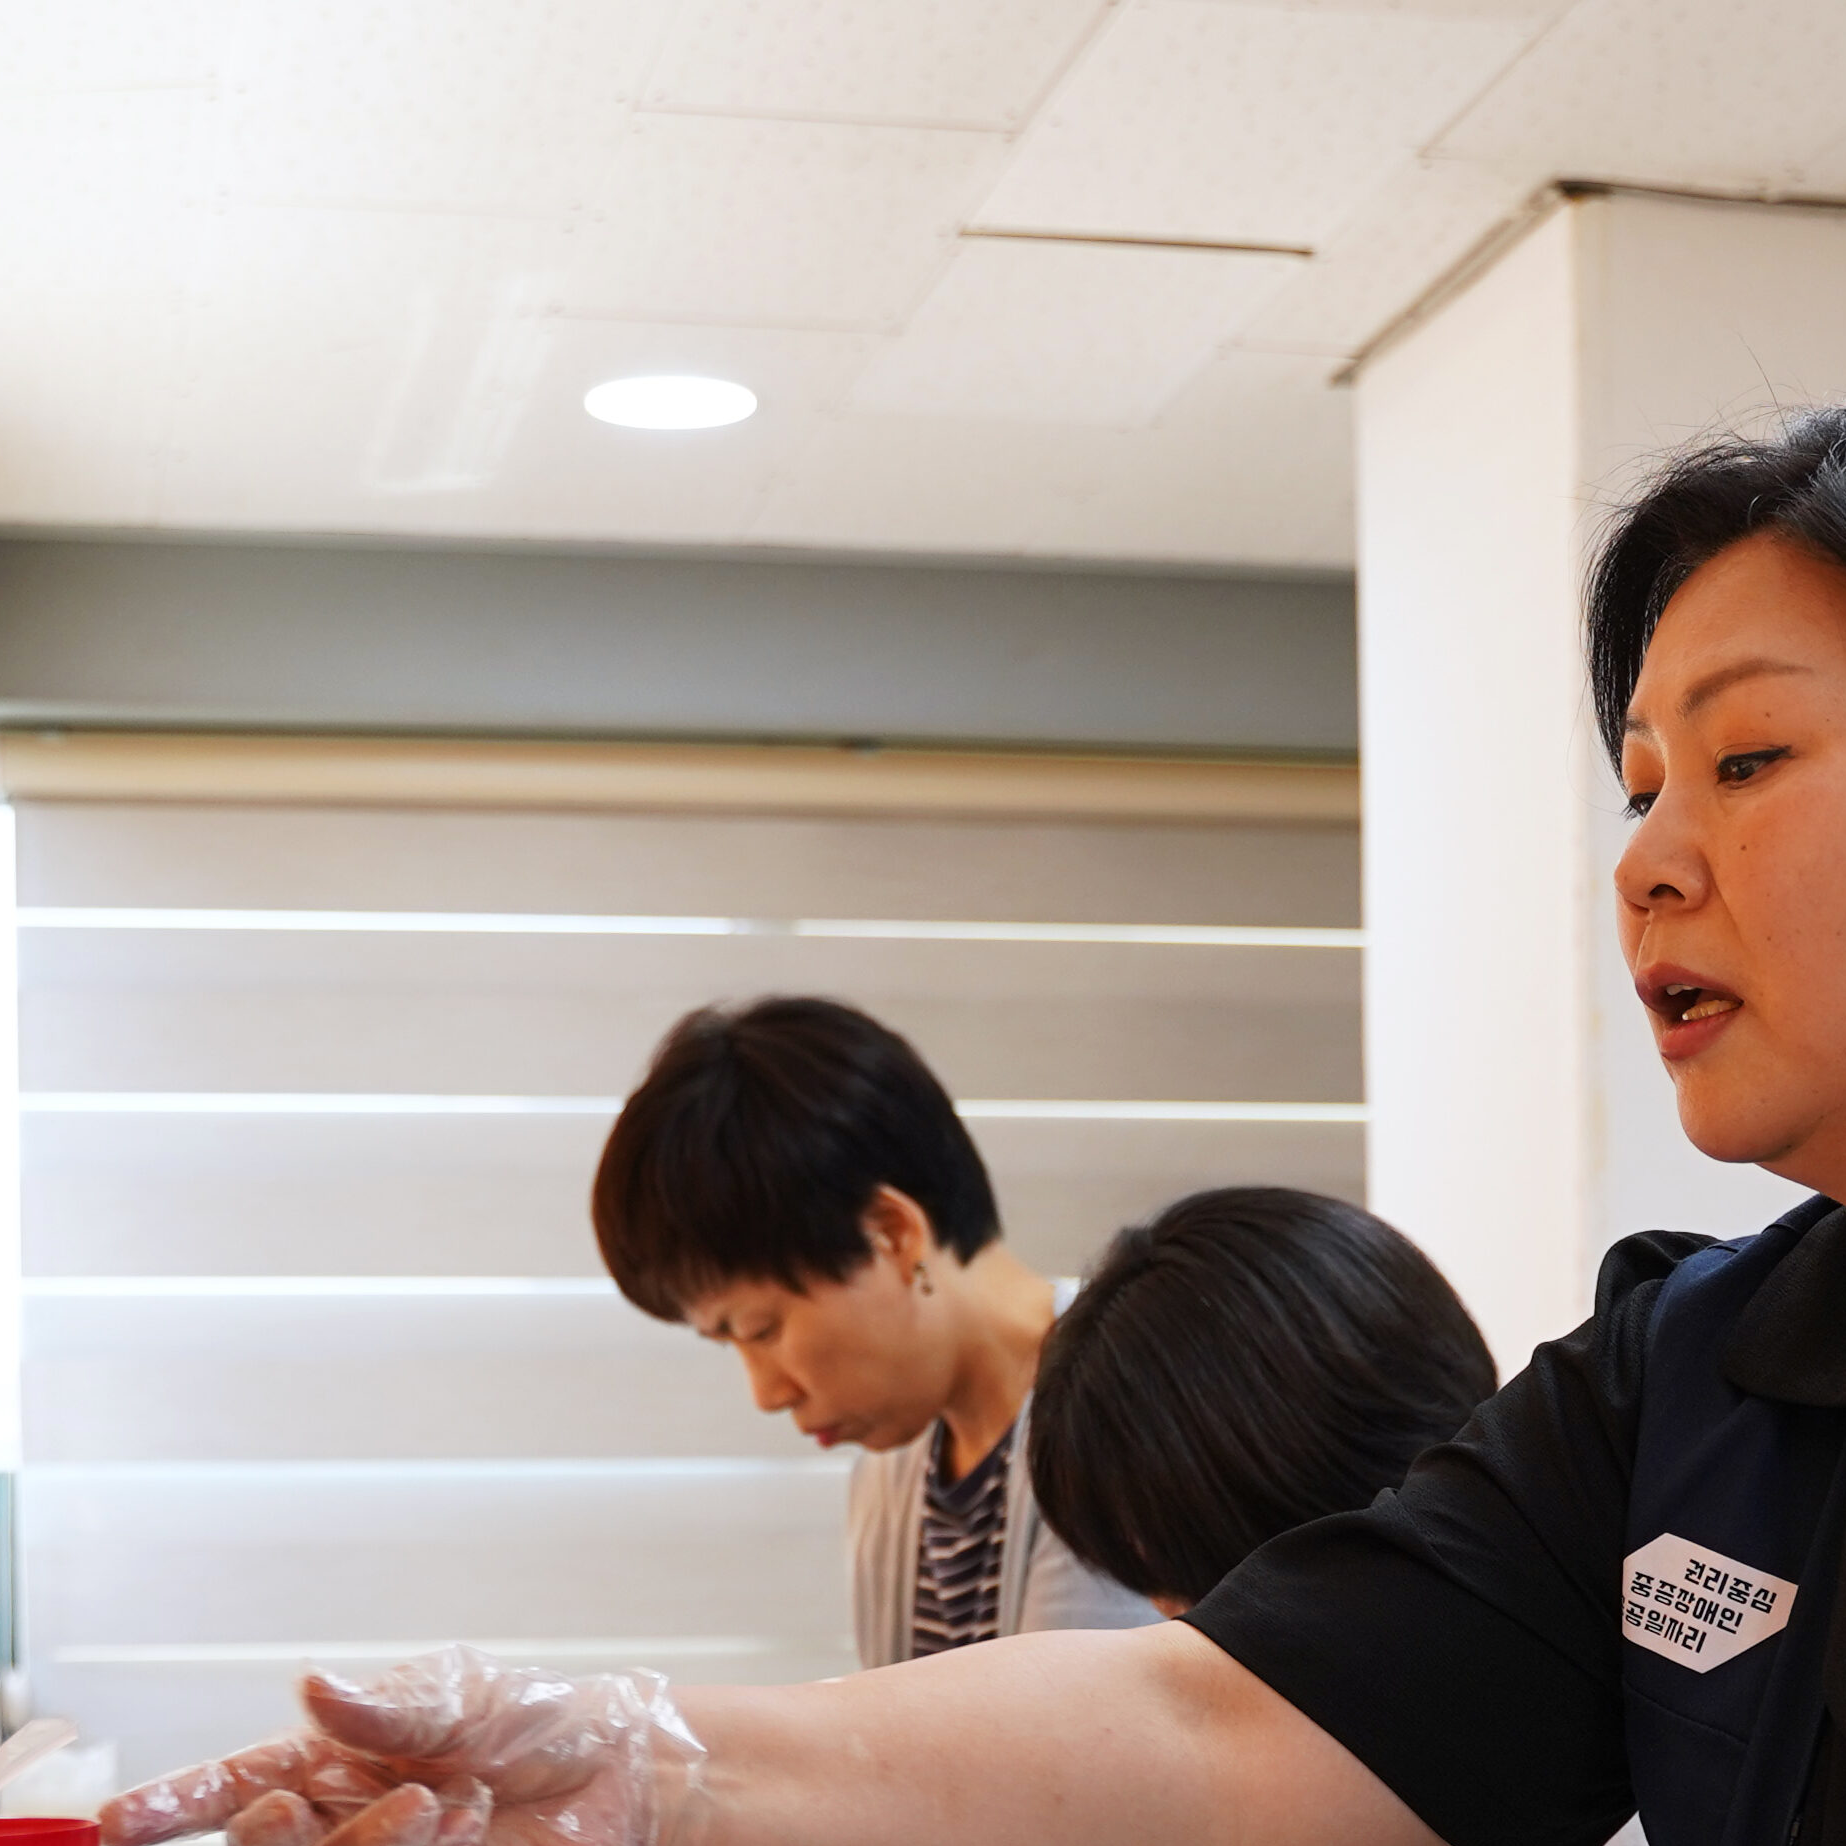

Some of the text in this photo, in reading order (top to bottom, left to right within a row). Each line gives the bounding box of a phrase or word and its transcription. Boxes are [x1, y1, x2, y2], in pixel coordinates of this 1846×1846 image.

[1630, 1571, 1743, 1635] 중증장애인
[1684, 1558, 1777, 1614] 권리중심
[1621, 1595, 1707, 1654] 공일자리
